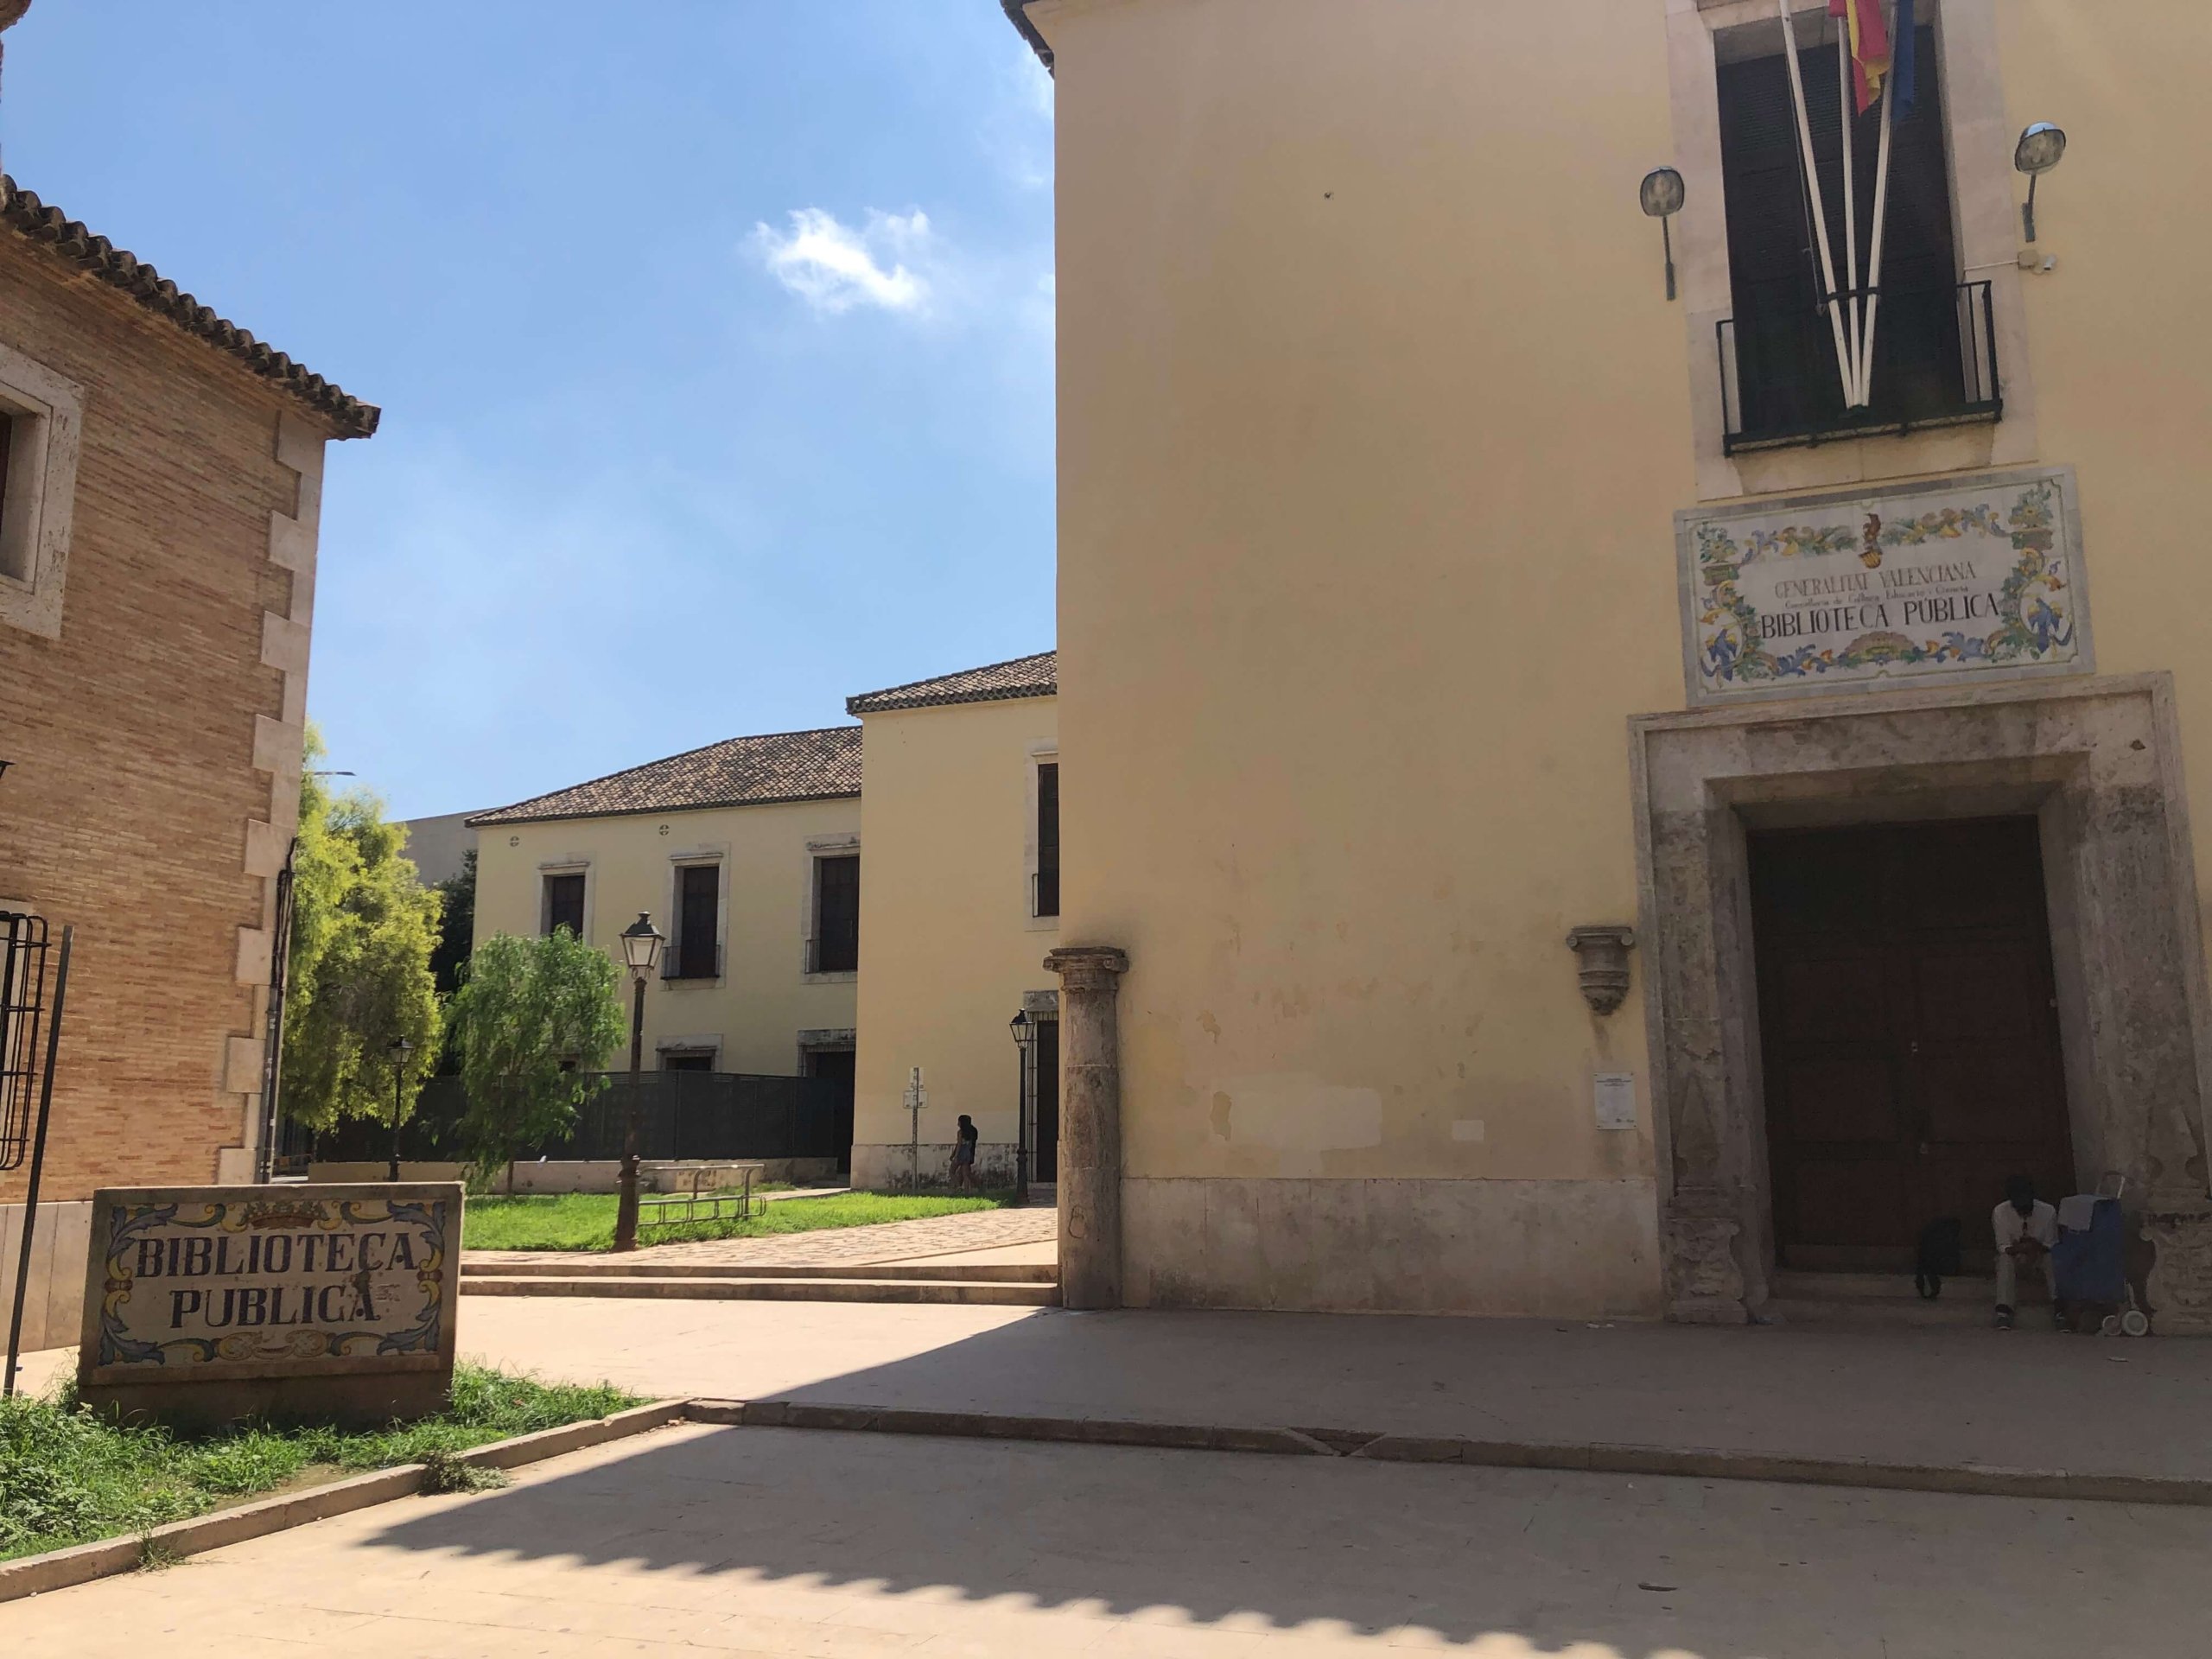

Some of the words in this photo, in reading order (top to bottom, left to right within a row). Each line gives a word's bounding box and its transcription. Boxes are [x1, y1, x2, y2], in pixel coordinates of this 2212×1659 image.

[1775, 572, 1868, 599] GENERALITAT
[1878, 561, 1976, 588] VALENCIANA
[1761, 604, 1889, 639] BIBLIOTECA
[1904, 593, 2000, 627] PÚBLICA
[135, 1232, 419, 1278] BIBLIOTECA
